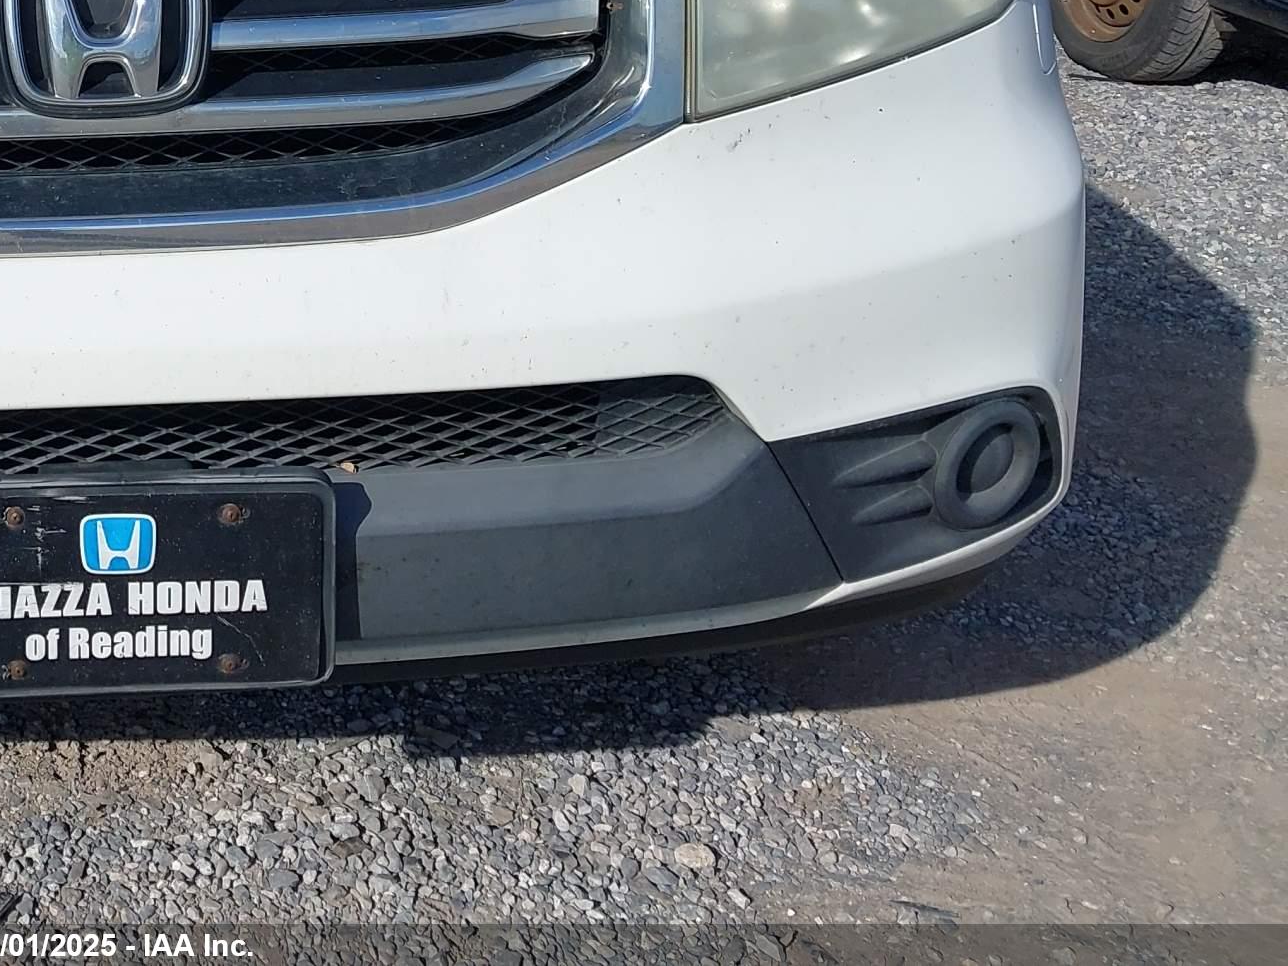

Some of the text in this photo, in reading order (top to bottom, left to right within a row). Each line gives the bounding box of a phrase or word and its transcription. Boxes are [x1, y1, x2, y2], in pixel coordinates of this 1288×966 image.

[127, 579, 268, 616] HONDA
[25, 625, 213, 661] of Reading
